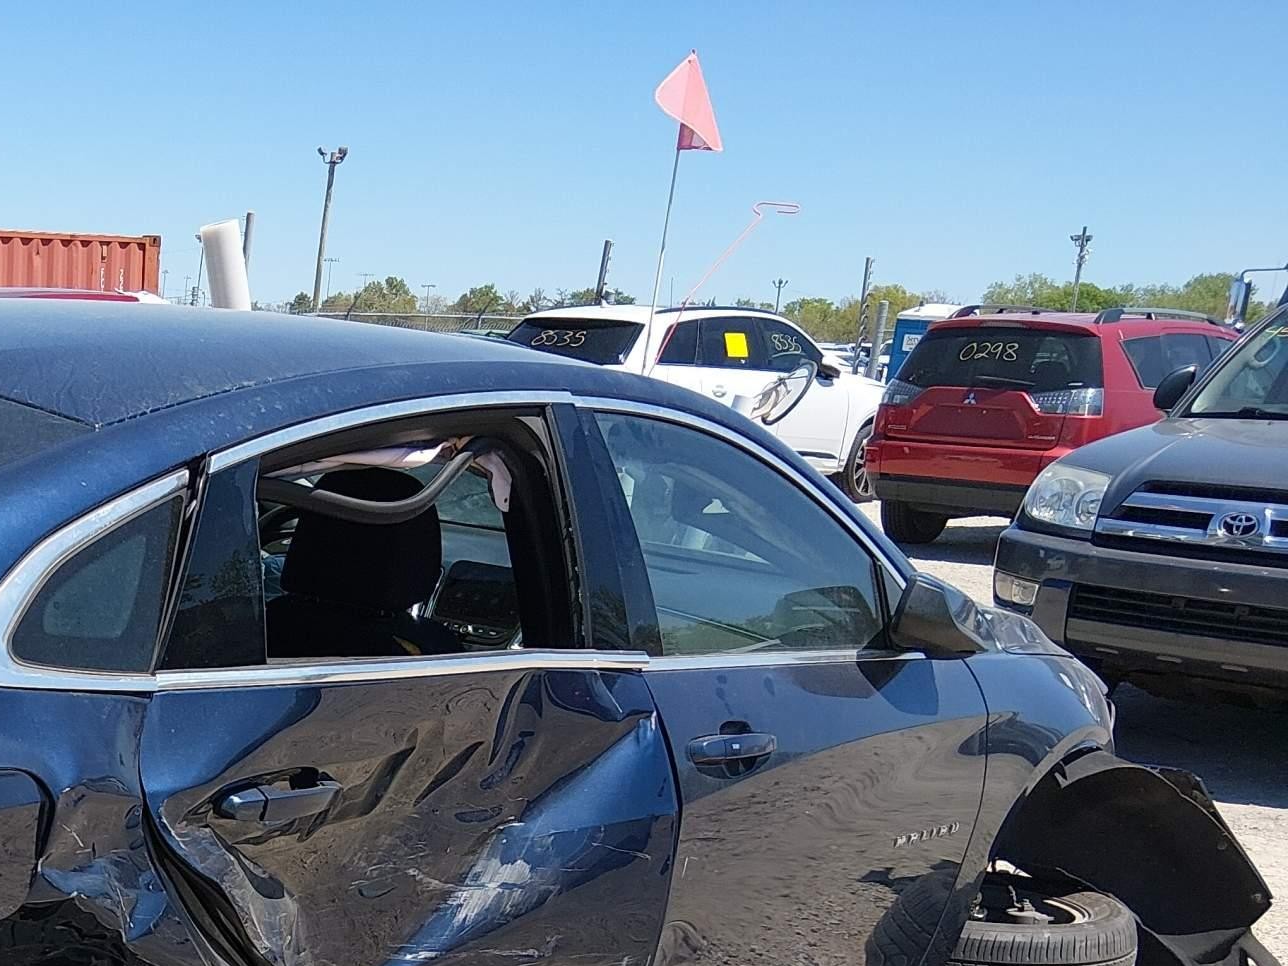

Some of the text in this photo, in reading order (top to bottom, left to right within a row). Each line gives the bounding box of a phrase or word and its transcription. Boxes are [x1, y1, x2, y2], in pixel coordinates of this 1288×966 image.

[531, 330, 587, 347] 8535
[771, 333, 802, 354] 8535
[959, 342, 1019, 361] 0298
